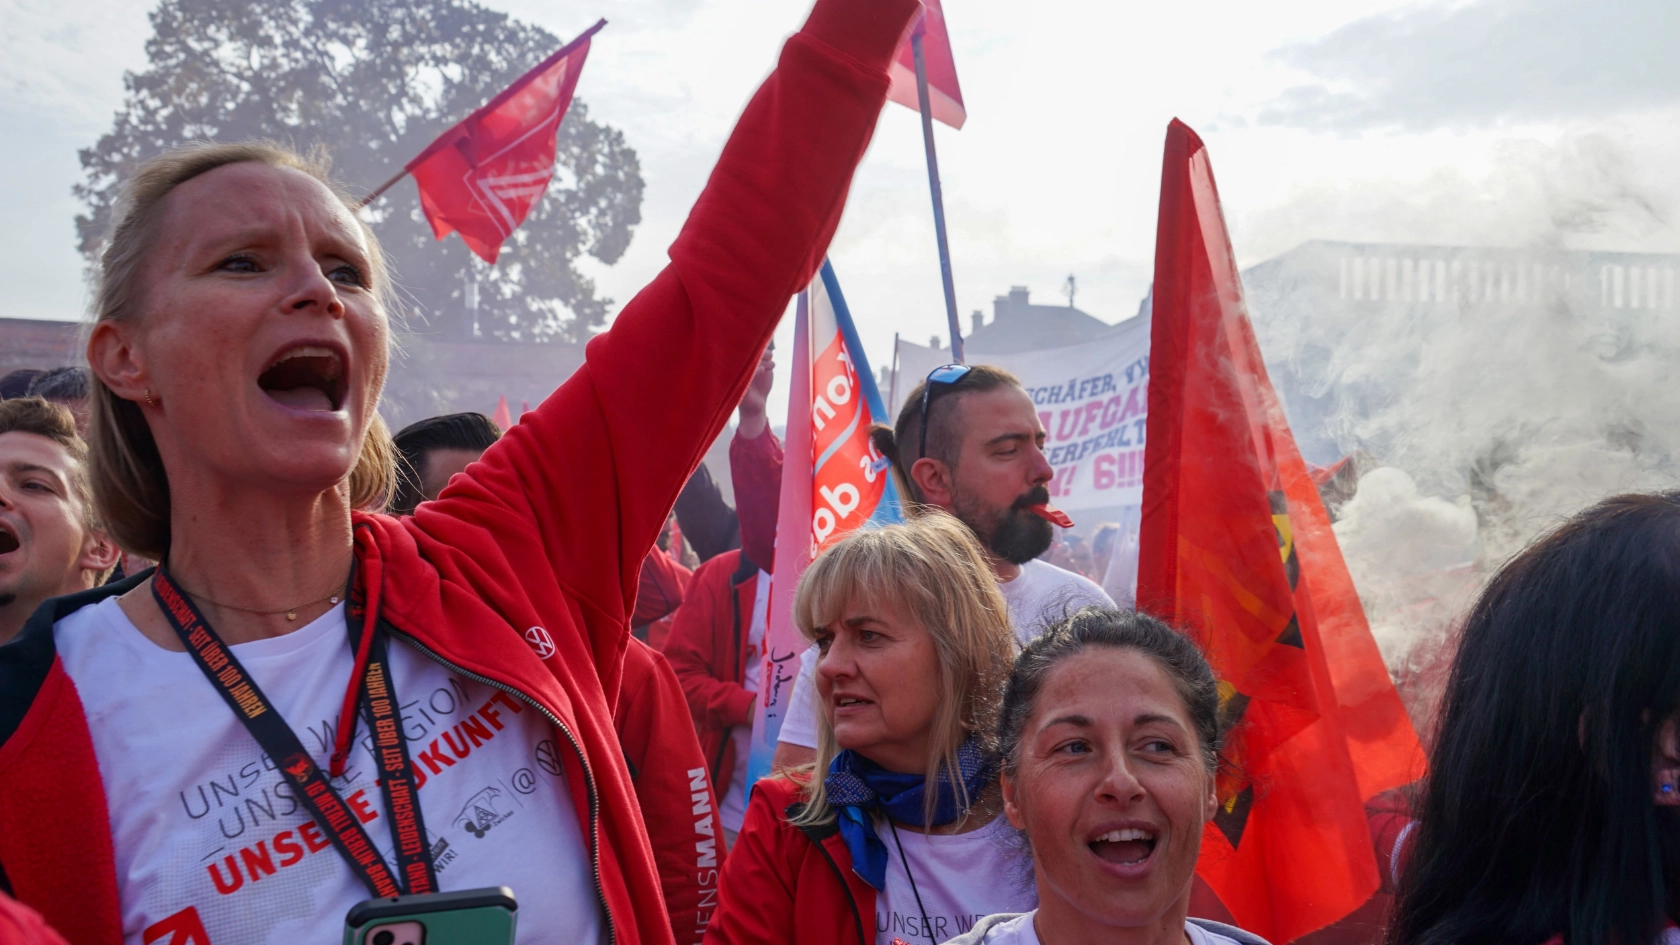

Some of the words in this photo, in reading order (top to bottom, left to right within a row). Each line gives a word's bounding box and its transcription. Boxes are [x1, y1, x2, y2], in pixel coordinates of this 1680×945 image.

[188, 625, 213, 650] SEIT
[200, 641, 229, 672] ÜBER
[217, 665, 242, 688] 100
[228, 681, 267, 719] JAHREN
[370, 699, 392, 718] 100
[376, 717, 400, 747] ÜBER
[382, 747, 405, 772] SEIT
[180, 752, 280, 820] UNSE
[304, 779, 327, 798] IG
[312, 792, 353, 833] METALL
[387, 778, 423, 856] LEIDENSCHAFT
[875, 911, 949, 938] UNSER
